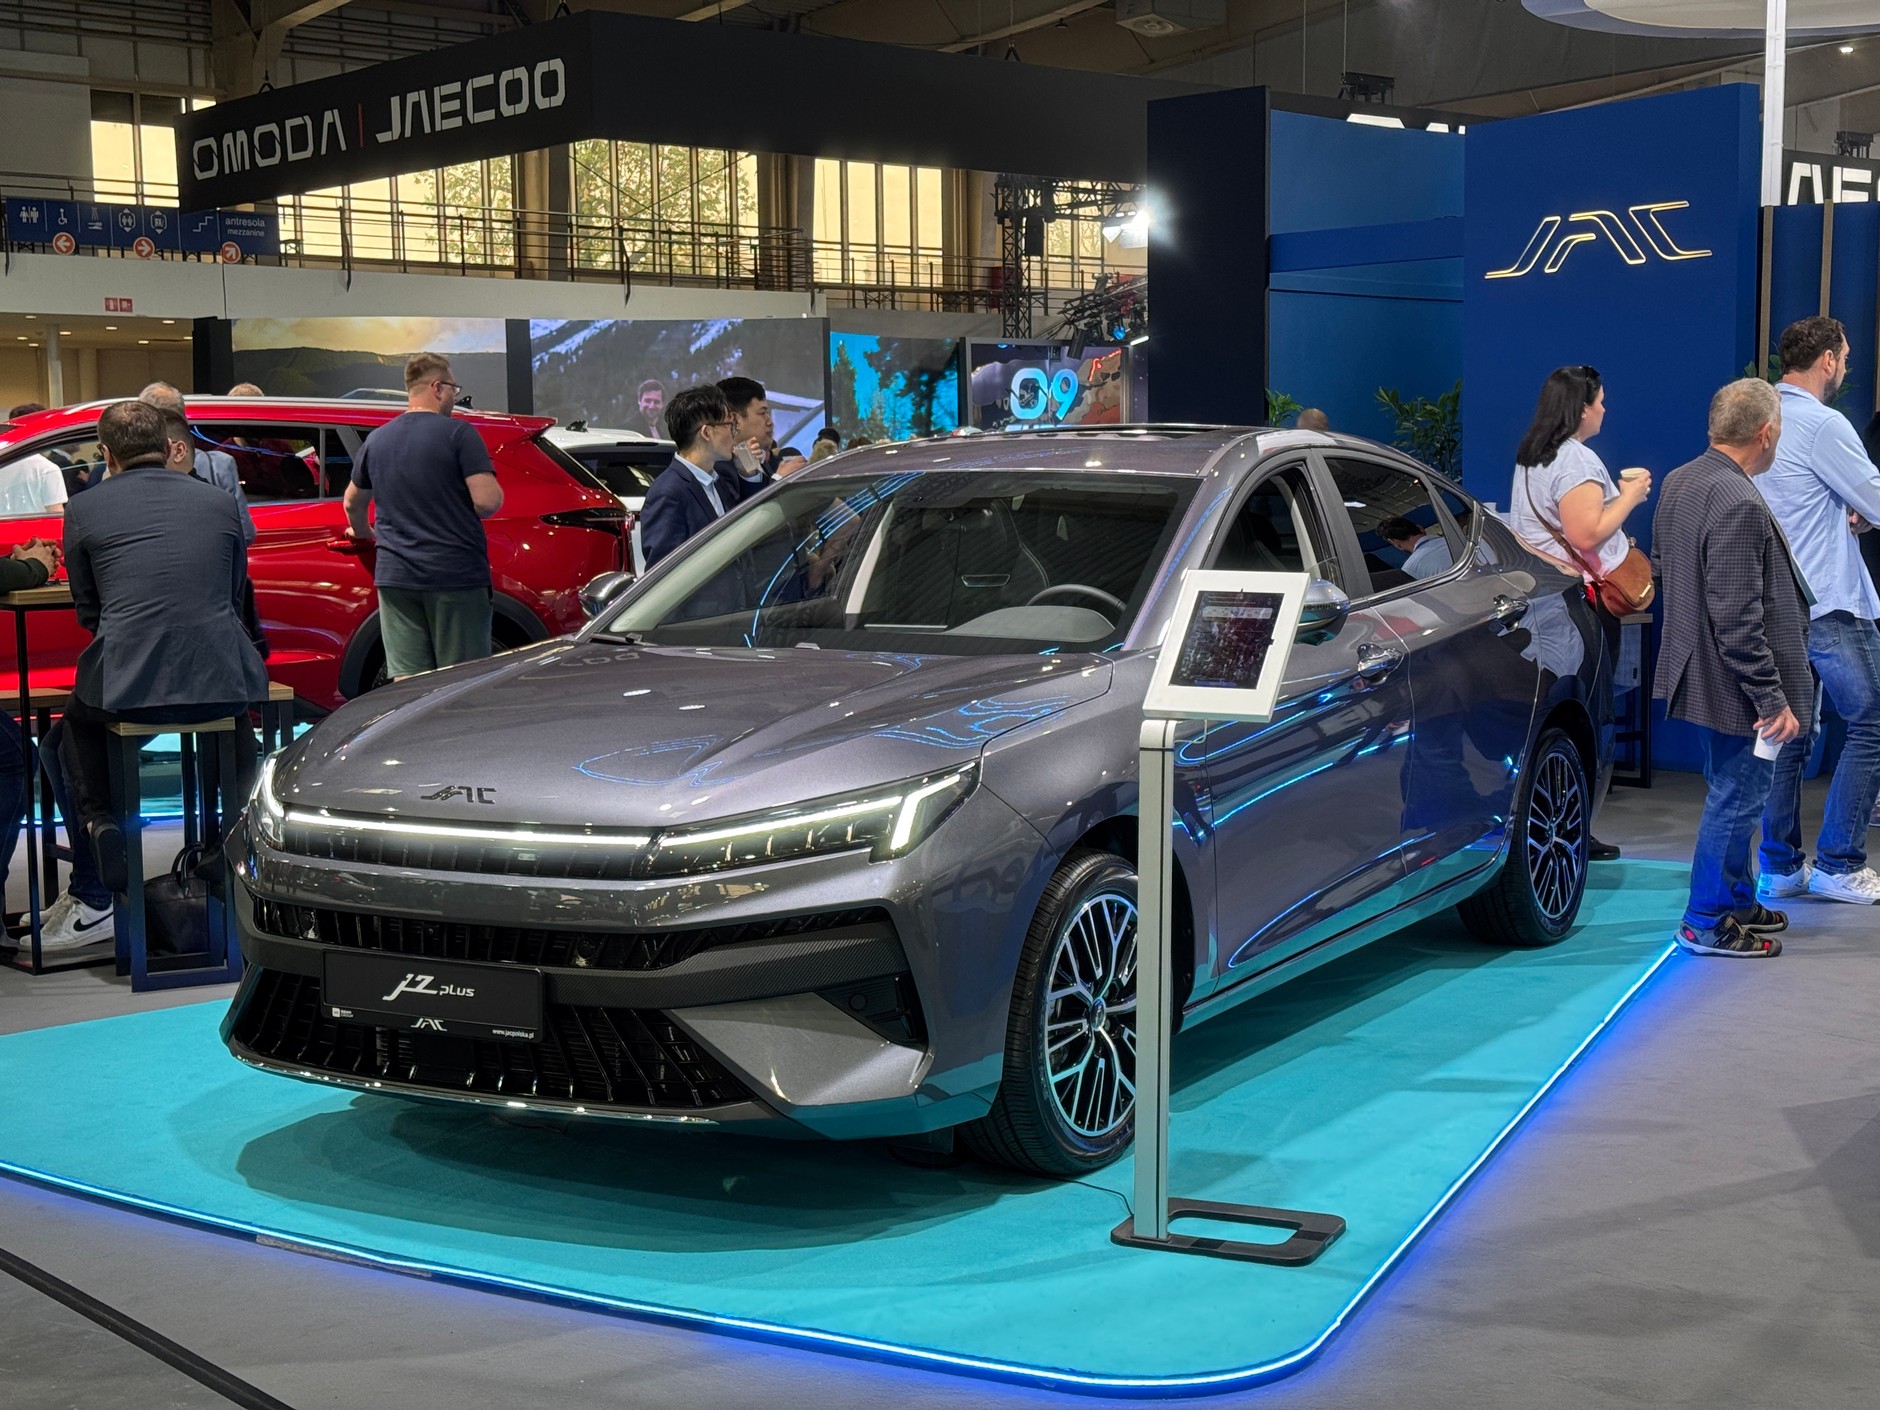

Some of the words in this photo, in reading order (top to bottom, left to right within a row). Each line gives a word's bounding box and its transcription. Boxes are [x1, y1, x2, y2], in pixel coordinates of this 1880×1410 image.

[192, 108, 347, 181] OMODA
[375, 57, 566, 144] JAECOO
[1787, 162, 1880, 206] AE
[225, 216, 266, 228] antresola
[227, 228, 265, 238] mezzanine
[1485, 200, 1713, 279] JAC
[420, 785, 497, 805] JAC
[411, 1017, 448, 1032] JAC
